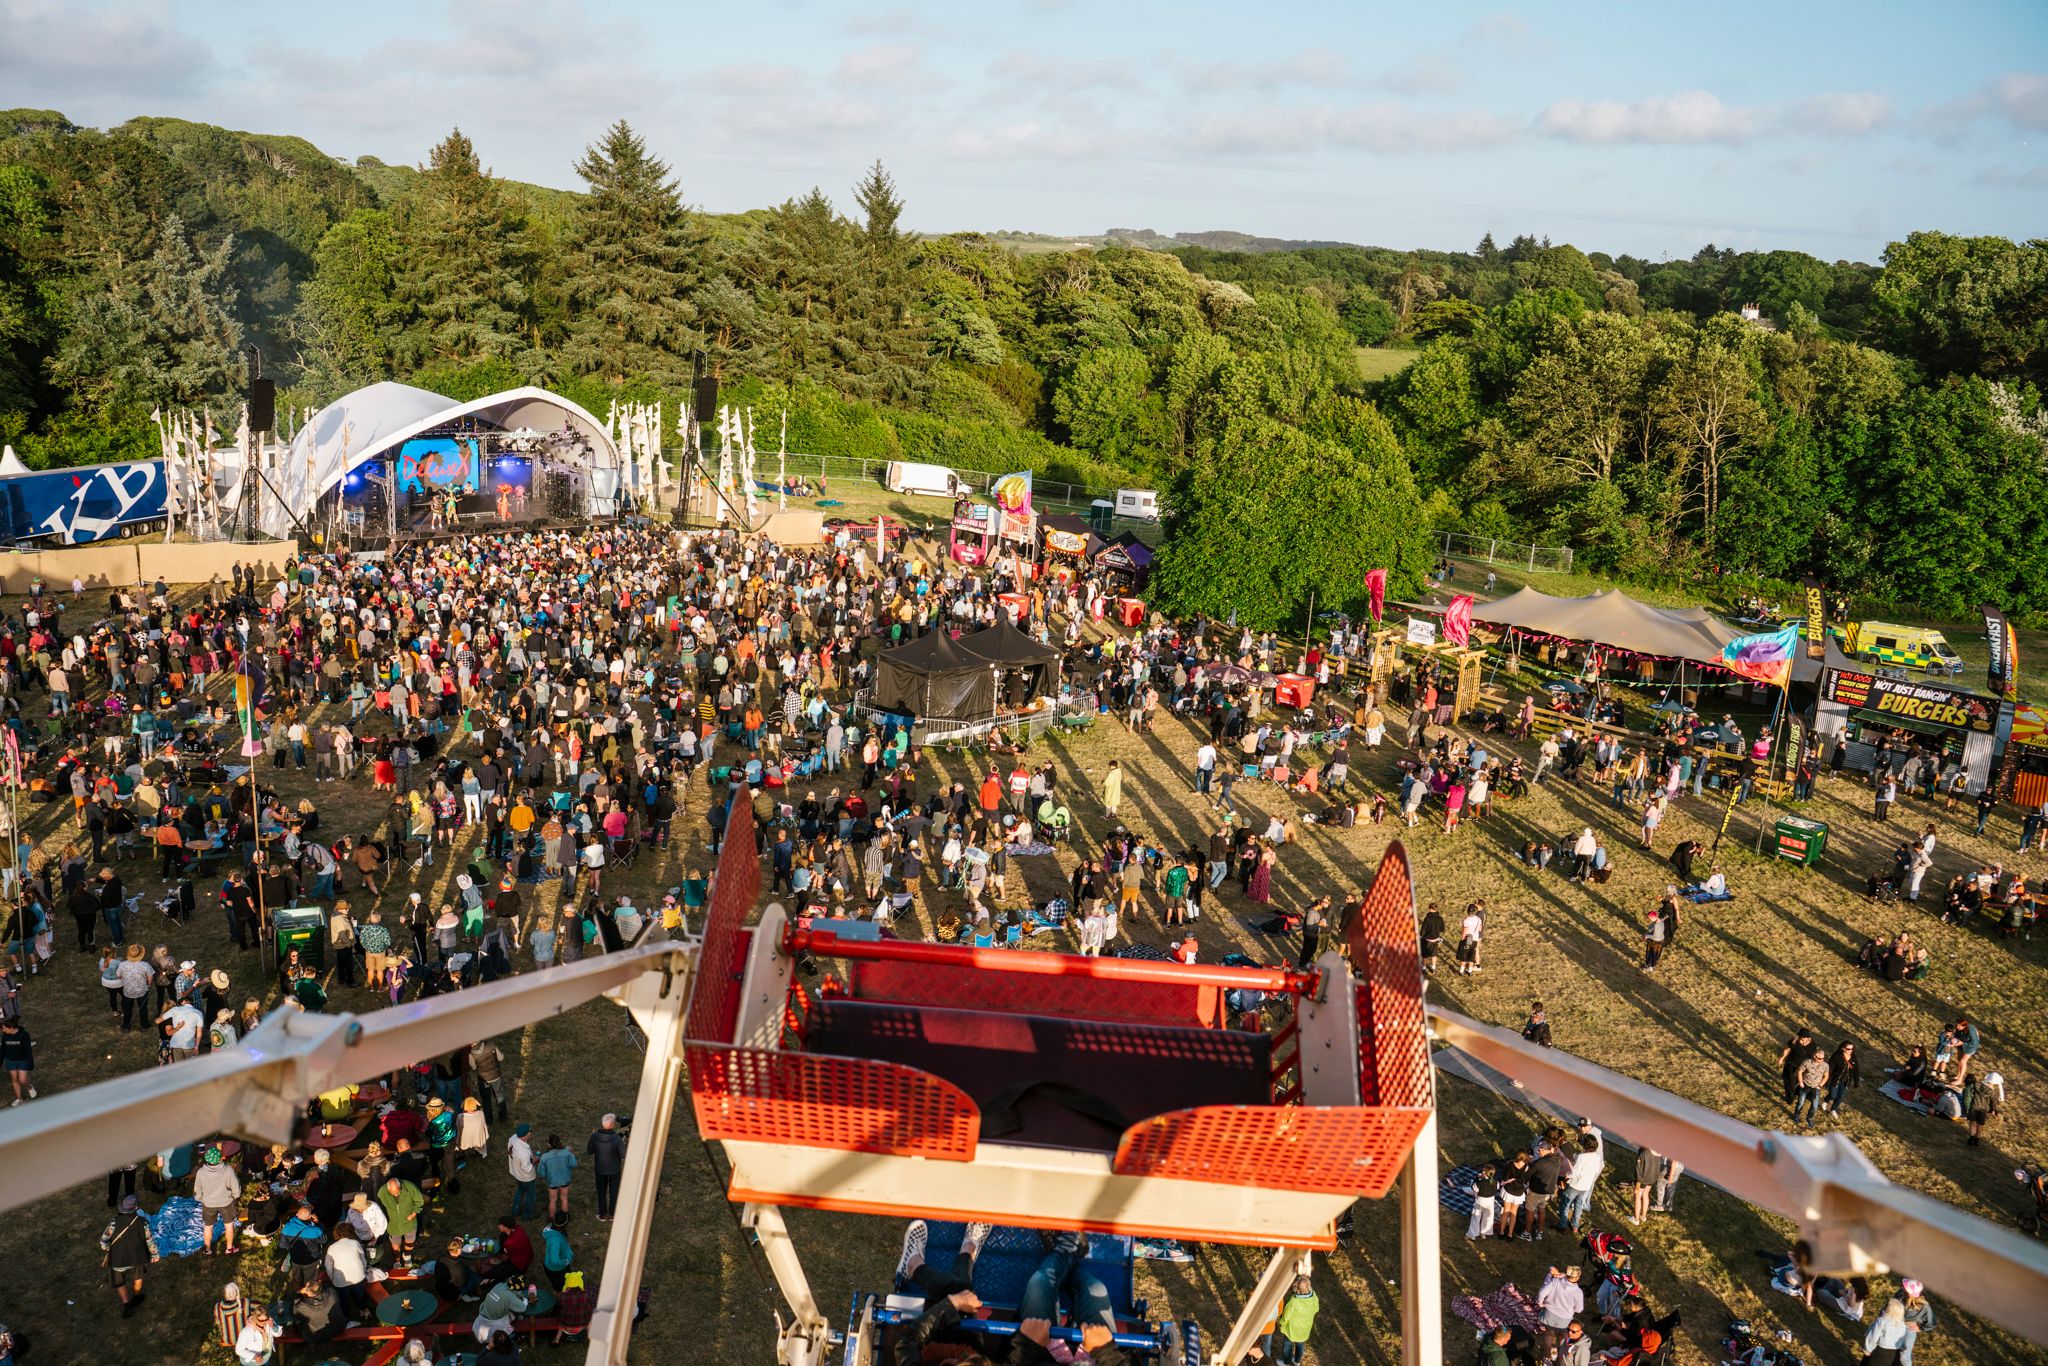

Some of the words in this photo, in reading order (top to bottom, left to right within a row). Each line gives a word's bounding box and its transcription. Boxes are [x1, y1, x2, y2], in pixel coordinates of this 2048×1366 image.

[1806, 586, 1823, 641] BURGERS
[1840, 671, 1854, 680] HOT
[1853, 674, 1873, 684] DOGS
[1873, 680, 1895, 692] NOT
[1893, 684, 1915, 696] JUST
[1913, 687, 1951, 703] BANGIN'
[1877, 693, 1969, 726] BURGERS
[1790, 723, 1800, 743] FRIES
[1786, 742, 1799, 768] LOADED
